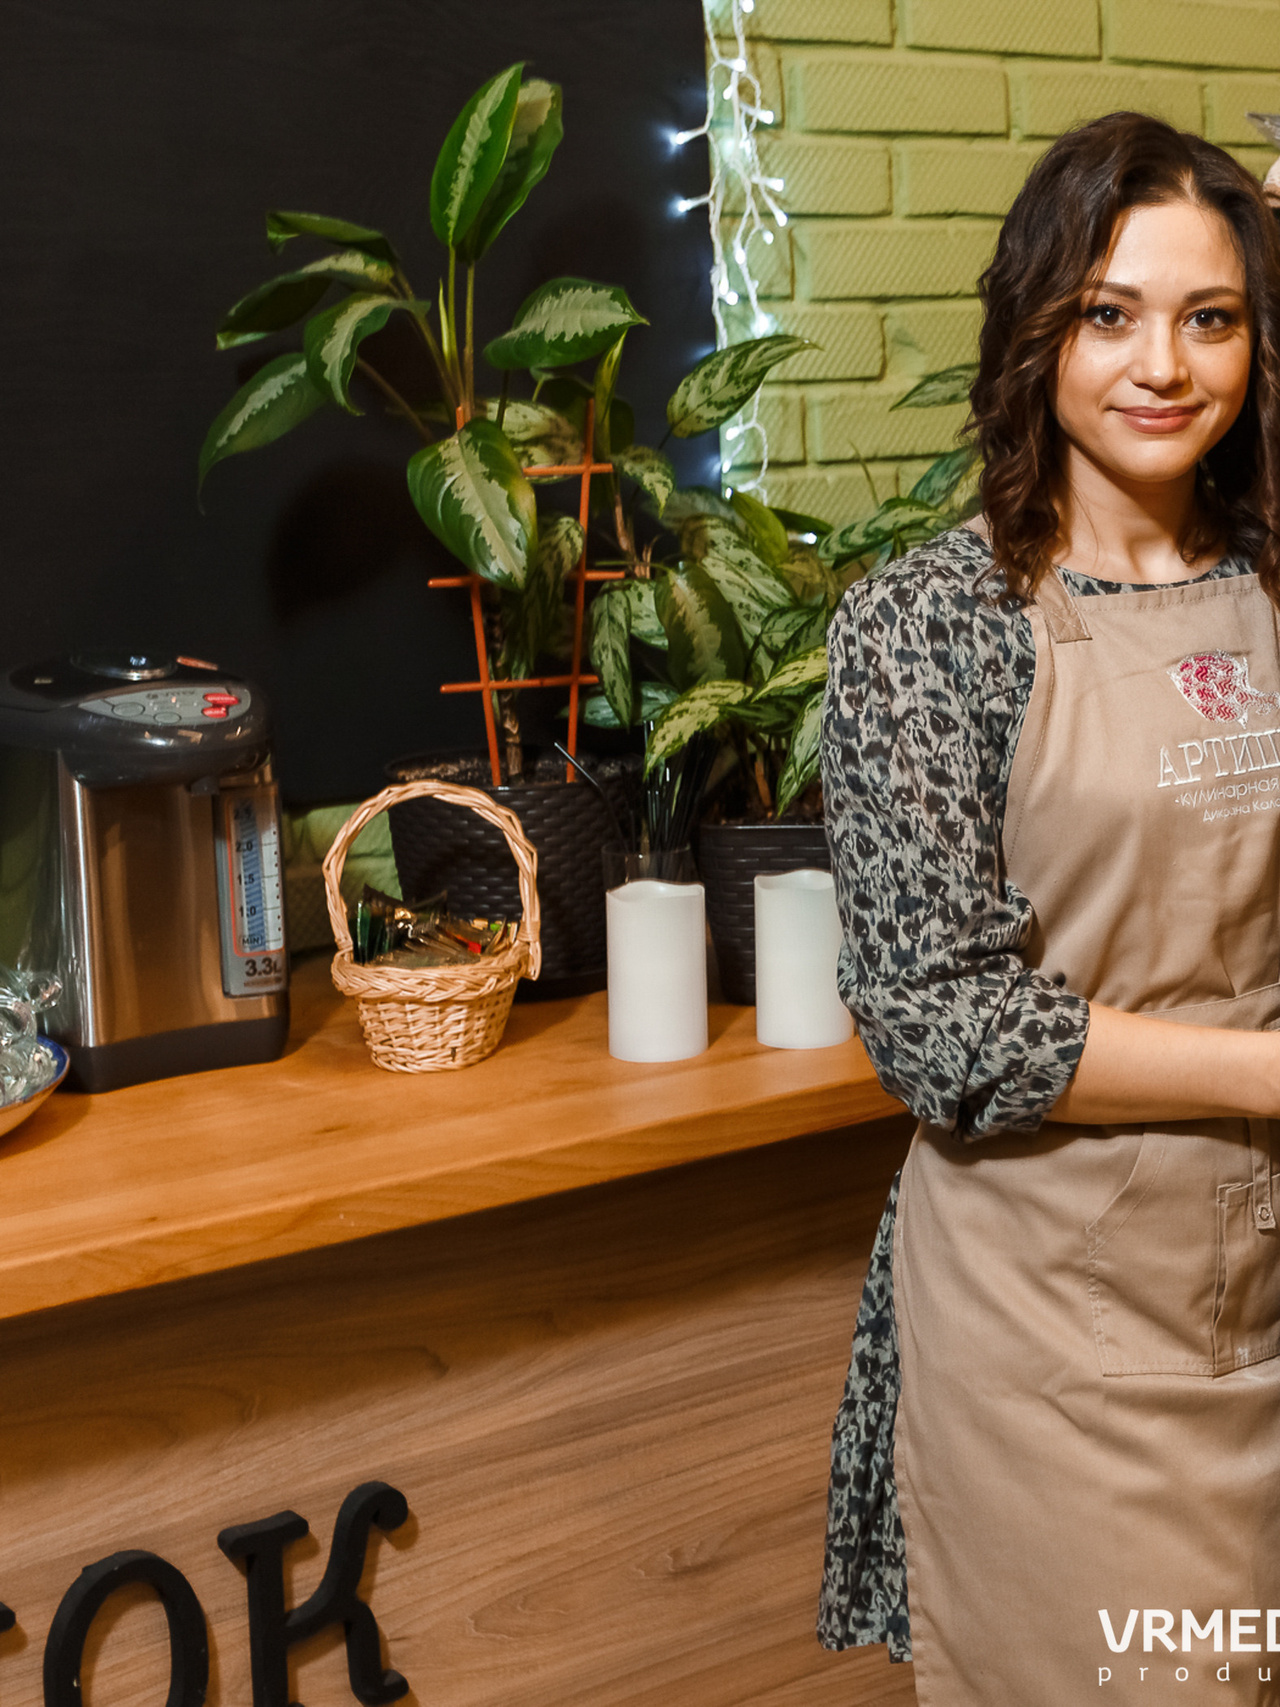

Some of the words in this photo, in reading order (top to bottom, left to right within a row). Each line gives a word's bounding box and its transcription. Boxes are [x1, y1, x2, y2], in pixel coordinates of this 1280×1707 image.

[236, 840, 253, 852] 2.0
[238, 873, 255, 886] 1.5
[239, 906, 257, 918] 1.0
[242, 936, 261, 946] MIN
[245, 957, 282, 978] 3.3L
[0, 1480, 410, 1707] ОК
